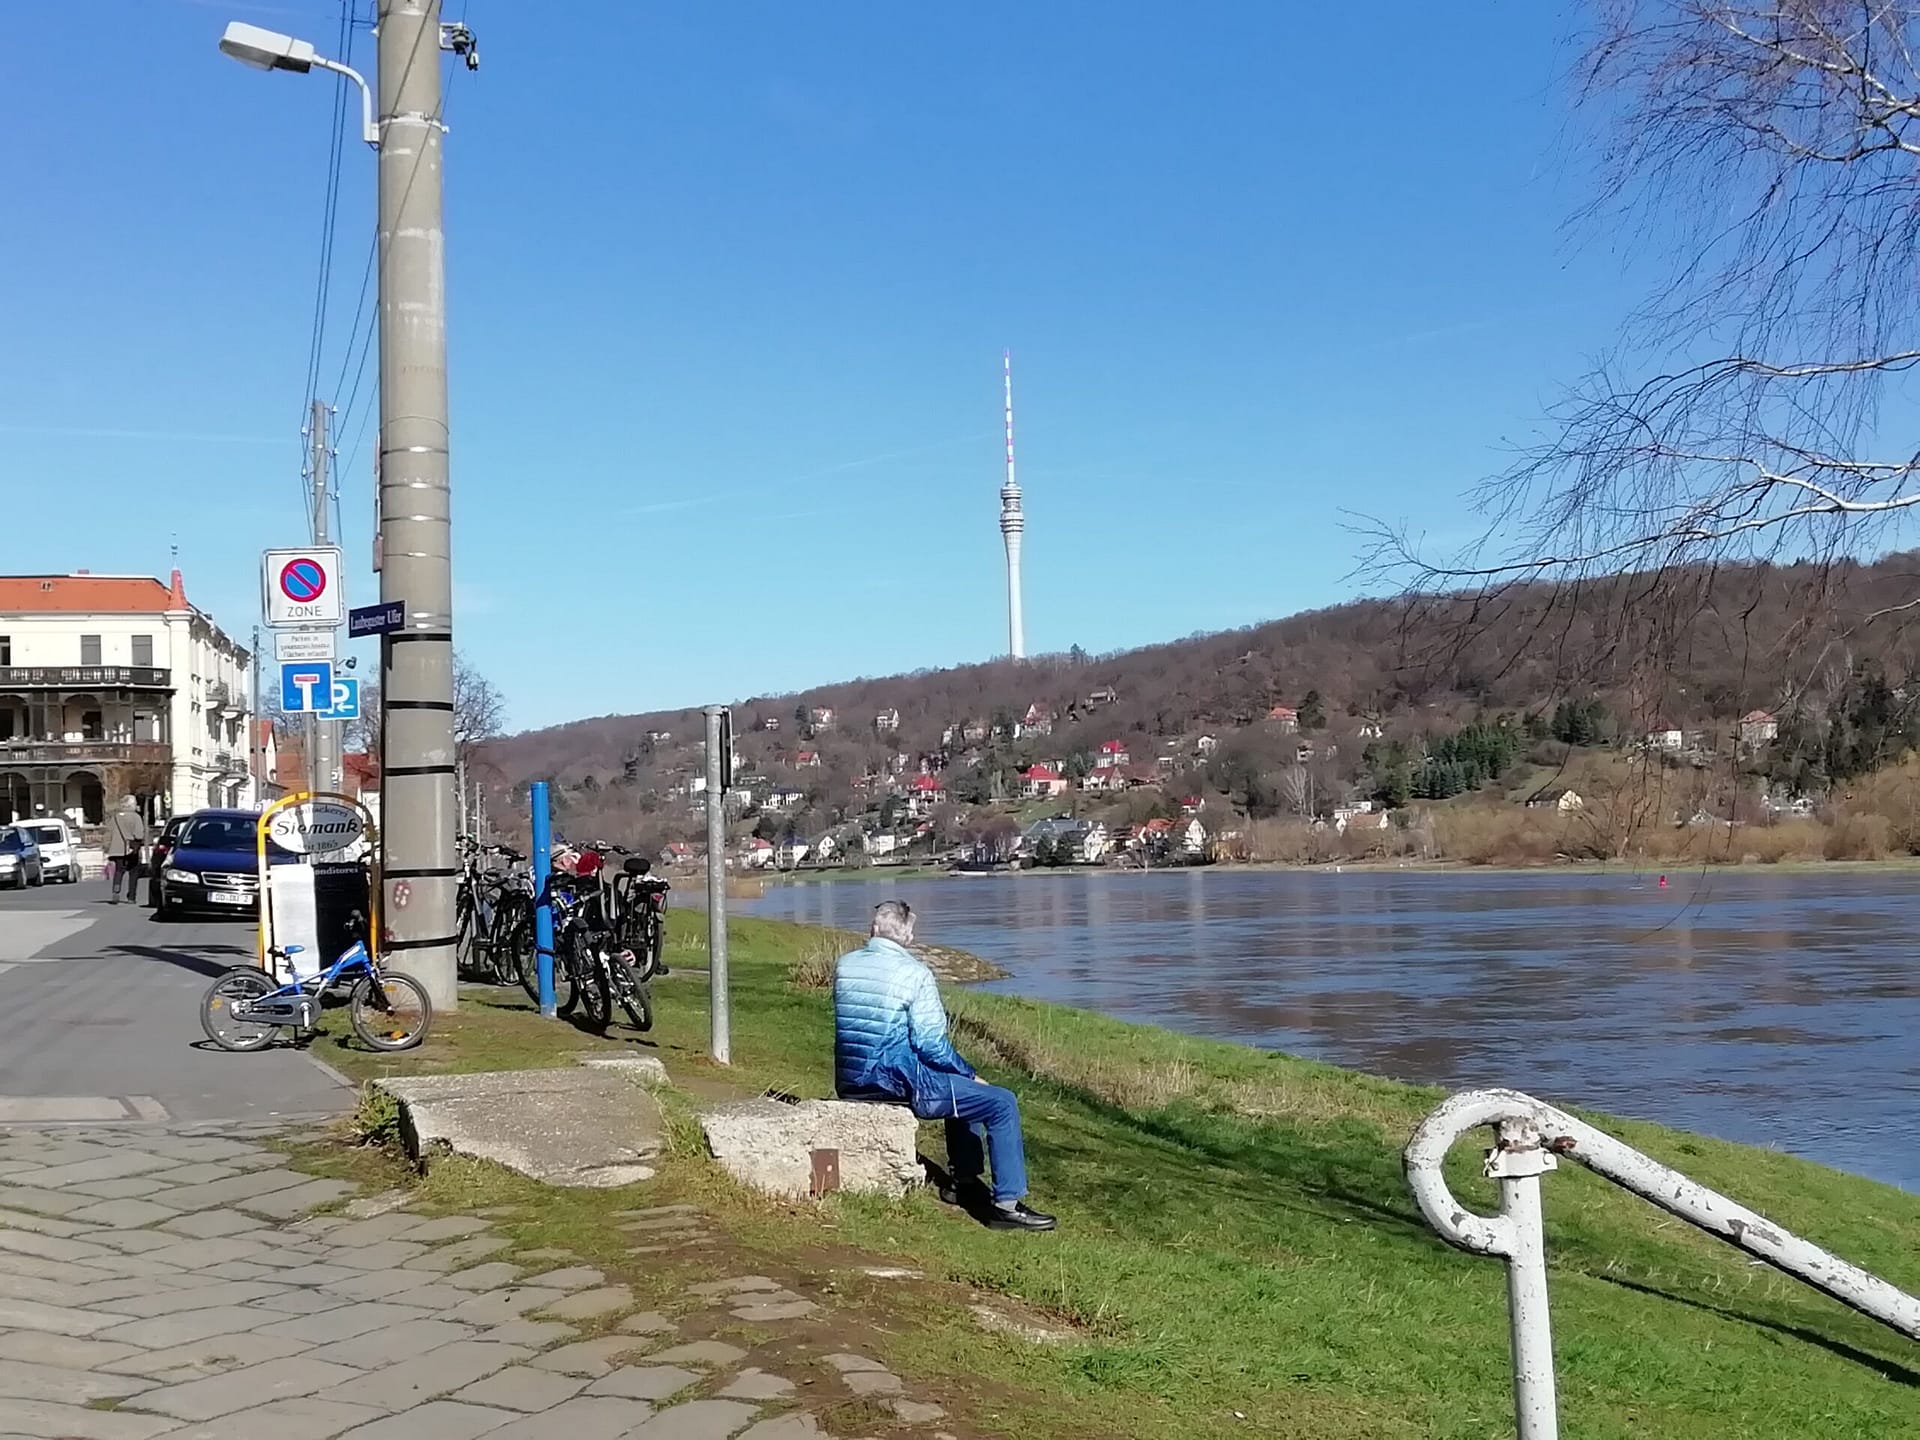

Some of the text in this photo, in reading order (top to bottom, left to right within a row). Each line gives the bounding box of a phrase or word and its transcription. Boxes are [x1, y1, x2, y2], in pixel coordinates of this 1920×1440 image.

[287, 606, 322, 617] ZONE
[274, 818, 359, 836] Siemank
[314, 866, 359, 875] onditorei
